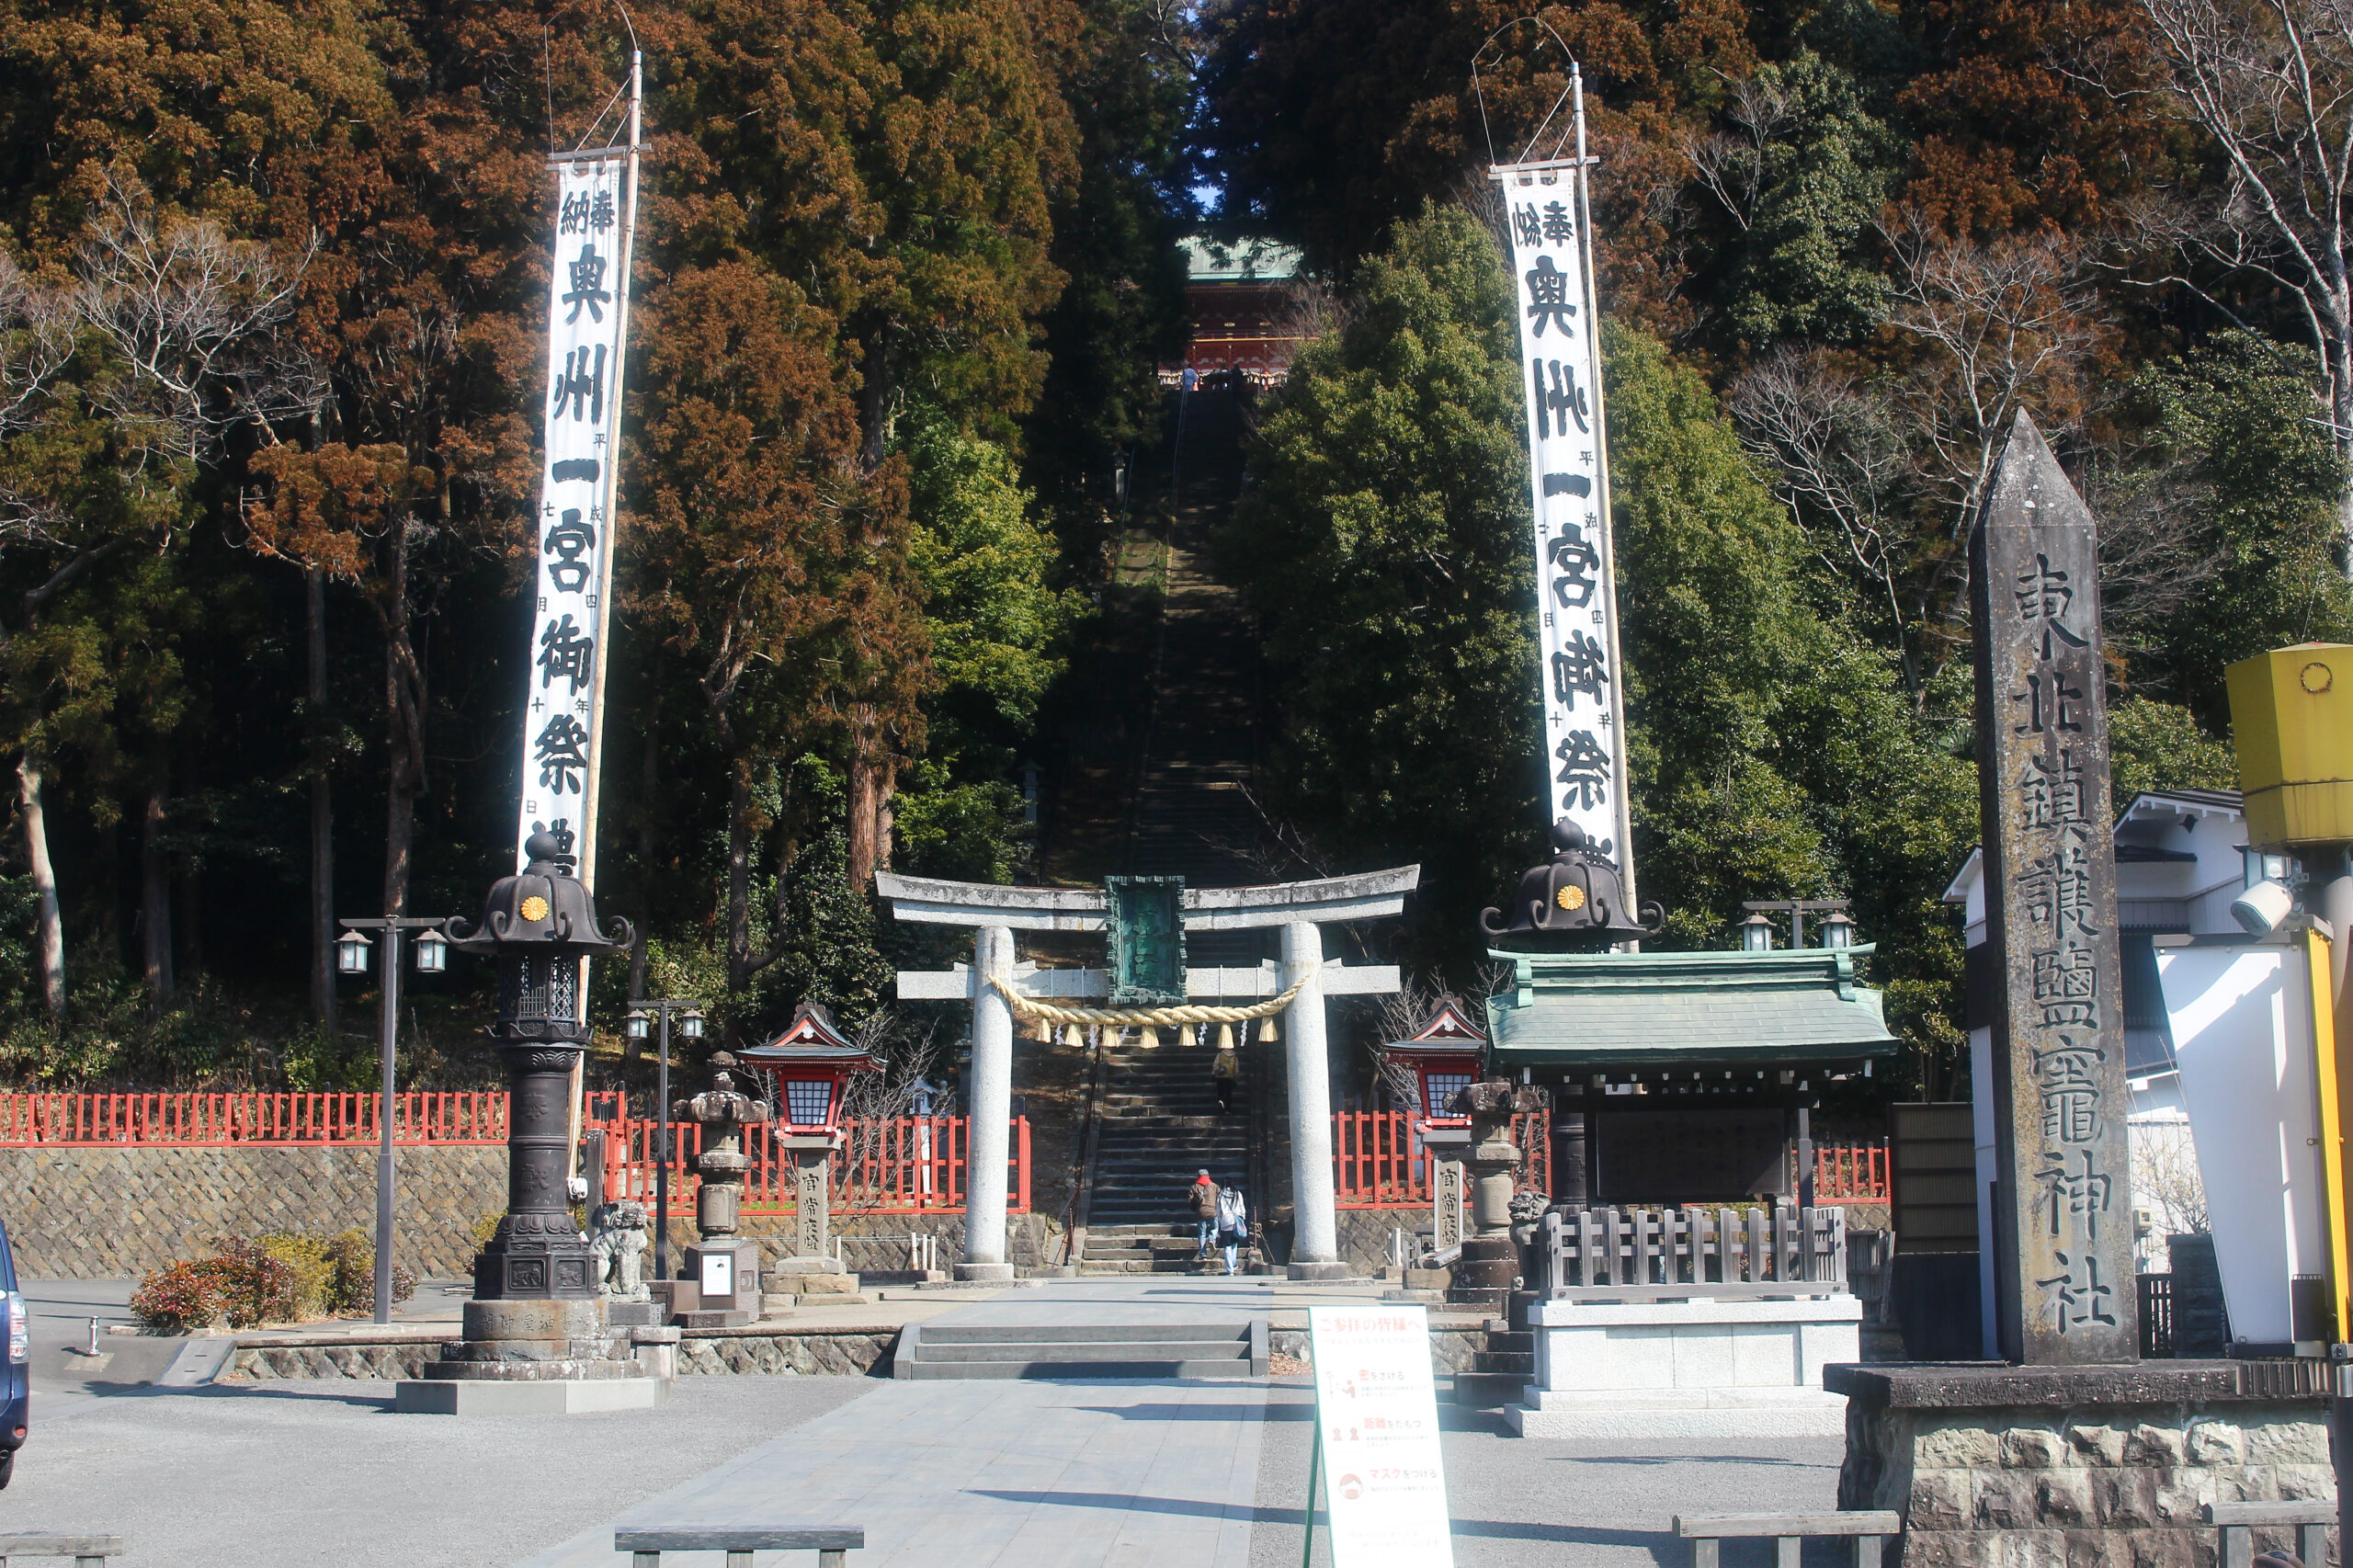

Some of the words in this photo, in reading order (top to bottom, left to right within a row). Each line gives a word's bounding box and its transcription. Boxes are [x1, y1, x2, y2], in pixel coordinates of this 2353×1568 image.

[561, 189, 616, 236] 奉納
[1320, 1316, 1422, 1332] ご参拝の皆様へ
[1364, 1417, 1421, 1430] 距離をたもつ
[1369, 1468, 1438, 1480] マスクをつける
